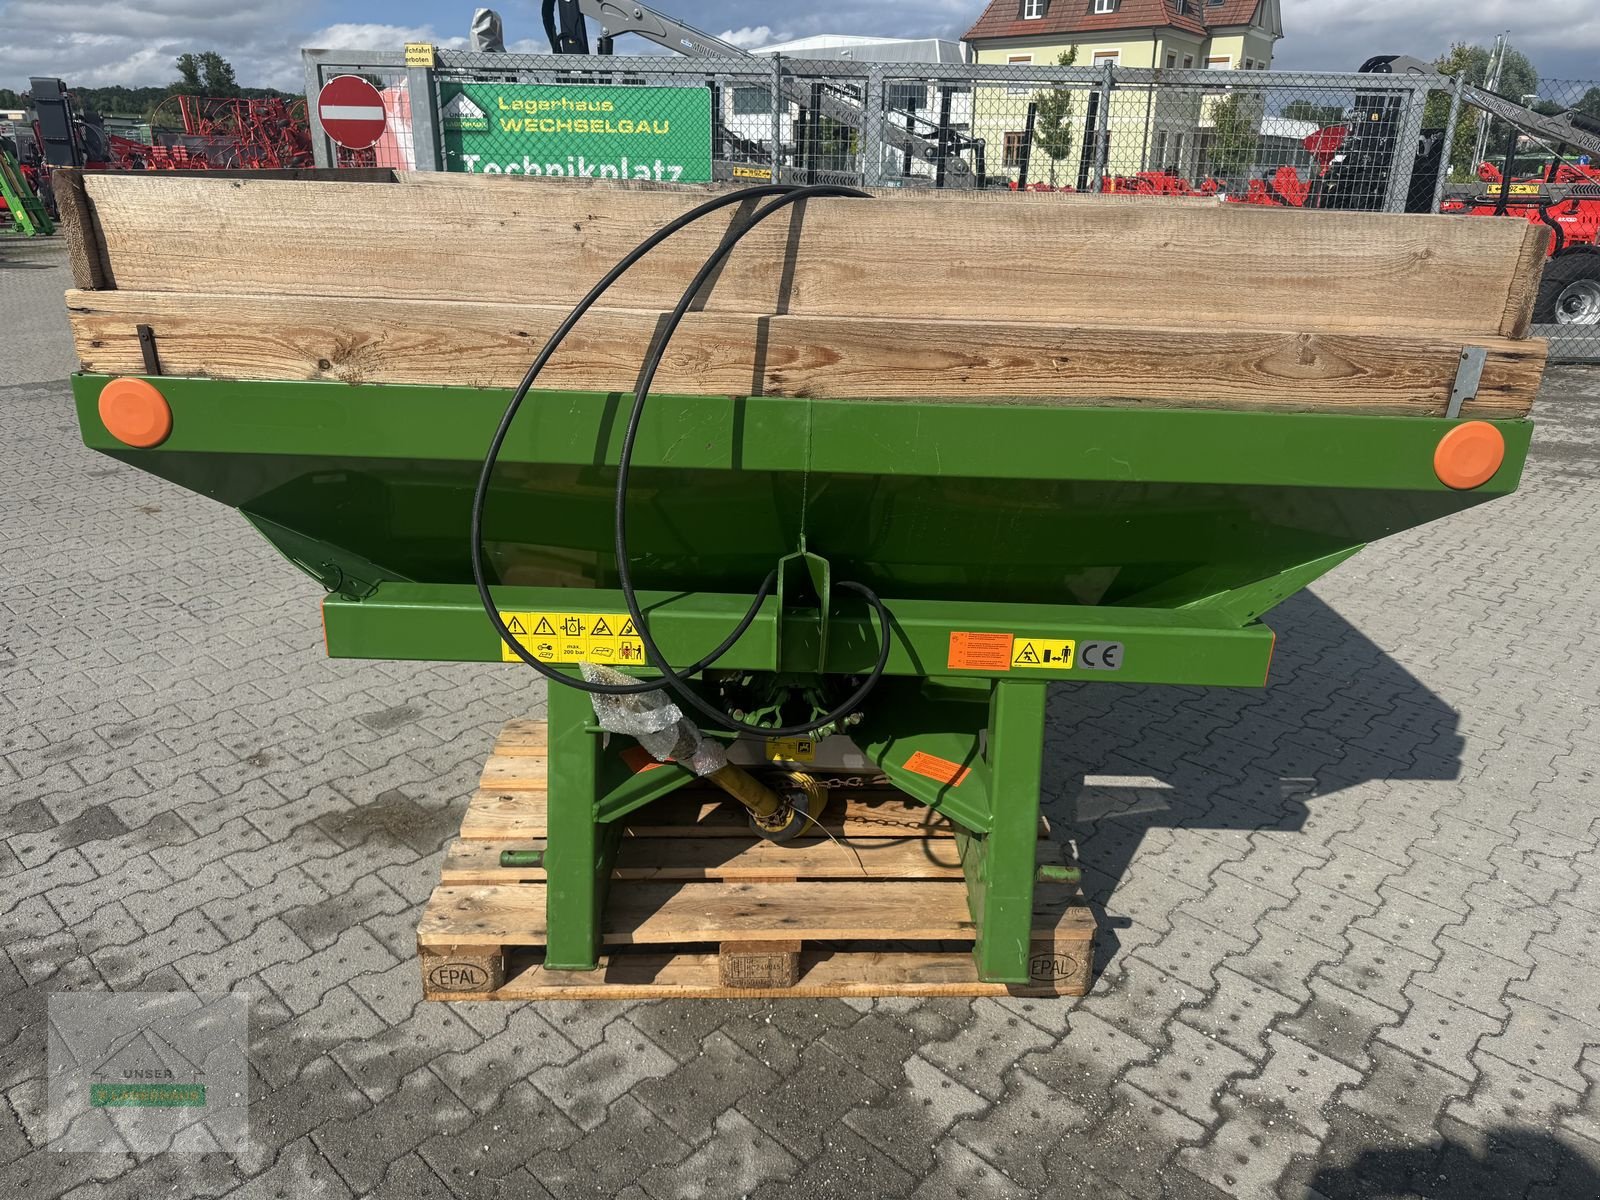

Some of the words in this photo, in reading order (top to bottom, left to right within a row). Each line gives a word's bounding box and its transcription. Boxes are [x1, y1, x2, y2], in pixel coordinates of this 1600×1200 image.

[498, 97, 613, 114] Lagerhaus
[500, 119, 670, 134] WECHSELGAU
[1082, 644, 1118, 667] CE
[1031, 959, 1070, 975] EPAL
[439, 969, 481, 985] EPAL
